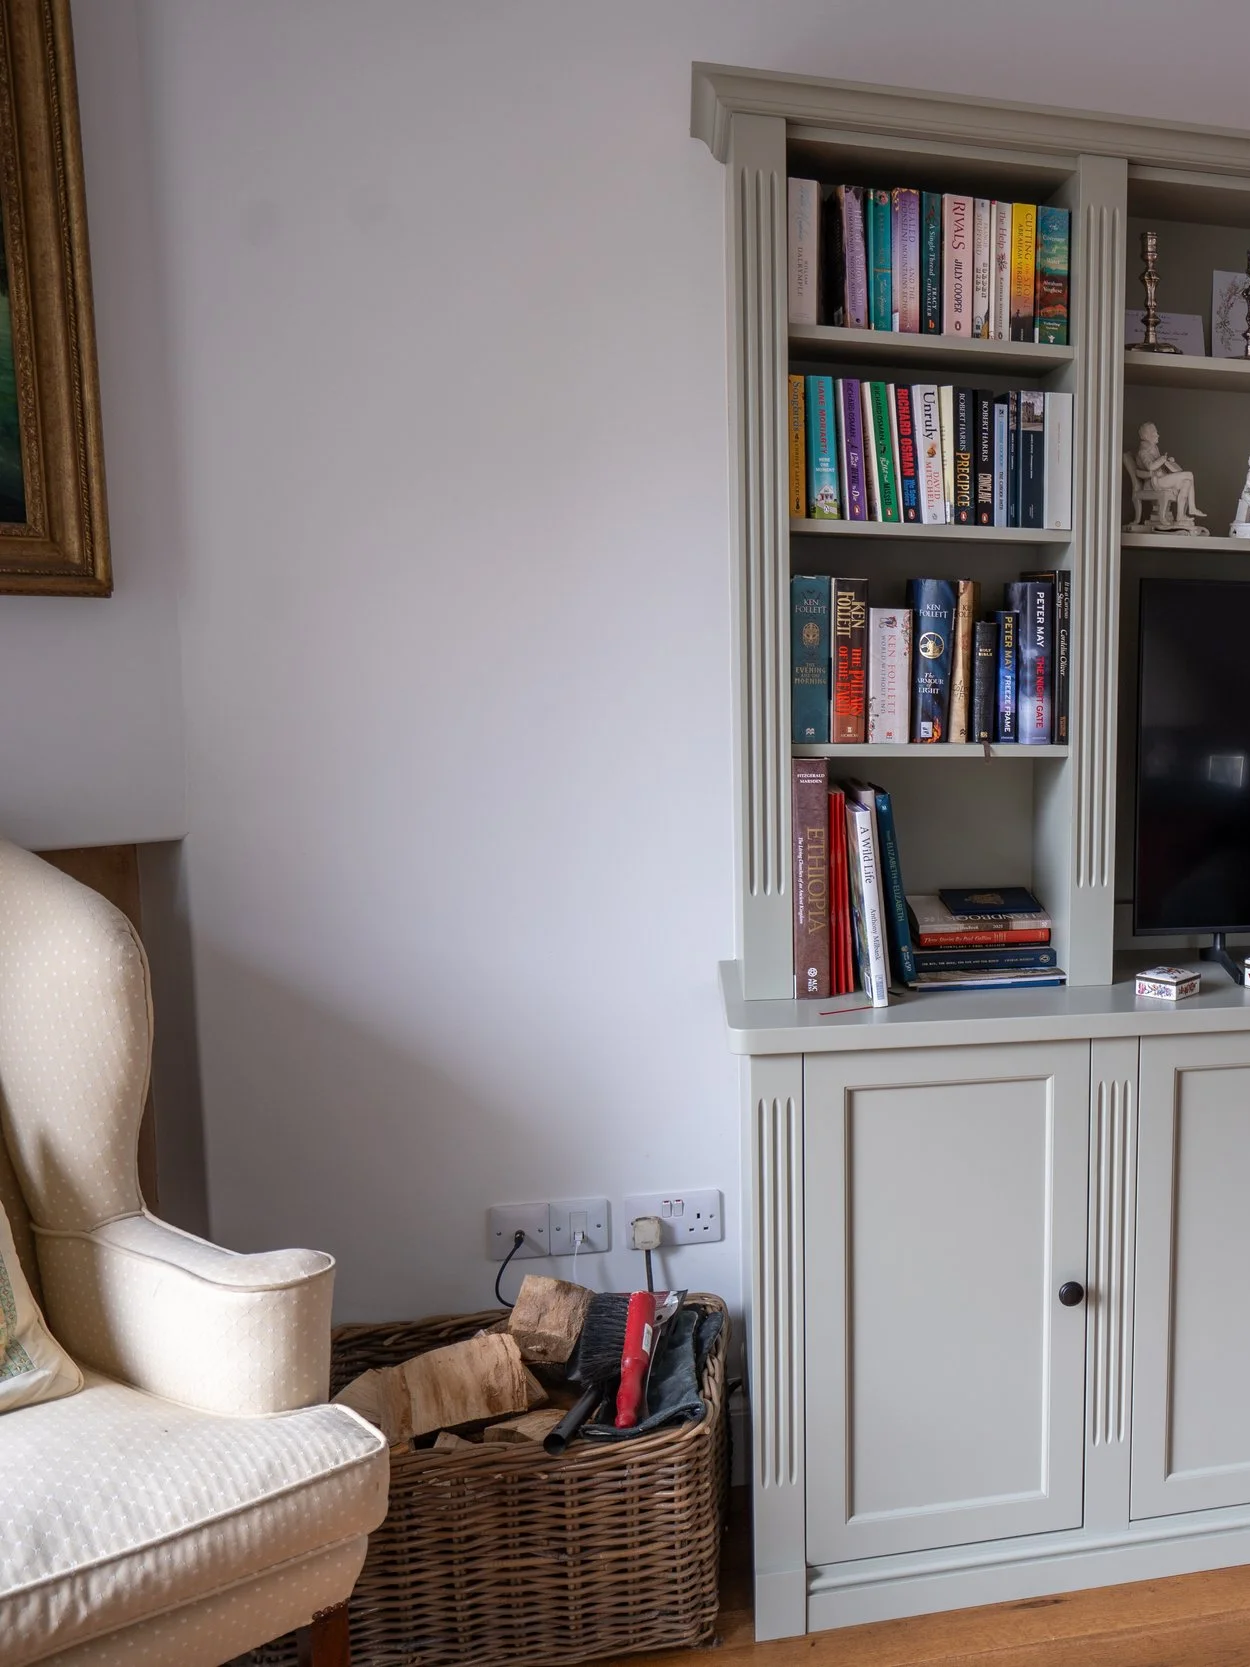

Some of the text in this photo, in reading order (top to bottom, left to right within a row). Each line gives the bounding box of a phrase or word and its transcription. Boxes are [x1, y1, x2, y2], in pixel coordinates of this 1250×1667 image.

[854, 210, 862, 229] Half
[855, 234, 862, 242] of
[952, 202, 965, 250] RIVALS
[998, 228, 1007, 249] Help
[856, 254, 864, 283] Yellow
[954, 259, 962, 313] JILLY COOPER
[791, 381, 801, 432] Songbirds
[846, 382, 856, 438] RICHARD OSMAN
[876, 416, 884, 440] OSMAN
[923, 392, 937, 440] Unruly
[819, 409, 827, 454] MORIARTY
[897, 388, 914, 476] RICHARD OSMAN
[850, 452, 858, 467] Last
[956, 452, 970, 507] PRECIPICE
[884, 483, 892, 505] MISSED
[909, 480, 915, 488] We
[926, 462, 934, 509] MITCHELL
[978, 473, 992, 504] CONCLAVE
[795, 605, 827, 614] FOLLETT
[837, 591, 855, 638] FOLLETT
[851, 602, 865, 629] KEN
[919, 611, 948, 619] FOLLETT
[1036, 592, 1045, 647] PETER MAY
[1056, 593, 1064, 608] Story
[1005, 616, 1013, 671] PETER MAY
[1036, 656, 1044, 675] THE
[835, 646, 851, 716] OF THE EARTH
[849, 648, 864, 716] THE PILLARS
[888, 634, 896, 716] KEN FOLLETT
[1036, 676, 1044, 704] NIGHT
[1036, 705, 1044, 728] GATE
[860, 826, 875, 884] A Wild Life
[806, 827, 826, 934] ETHIOPIA
[886, 842, 904, 922] ELIZABETH ELIZABETH
[869, 908, 882, 961] Anthony Milbank
